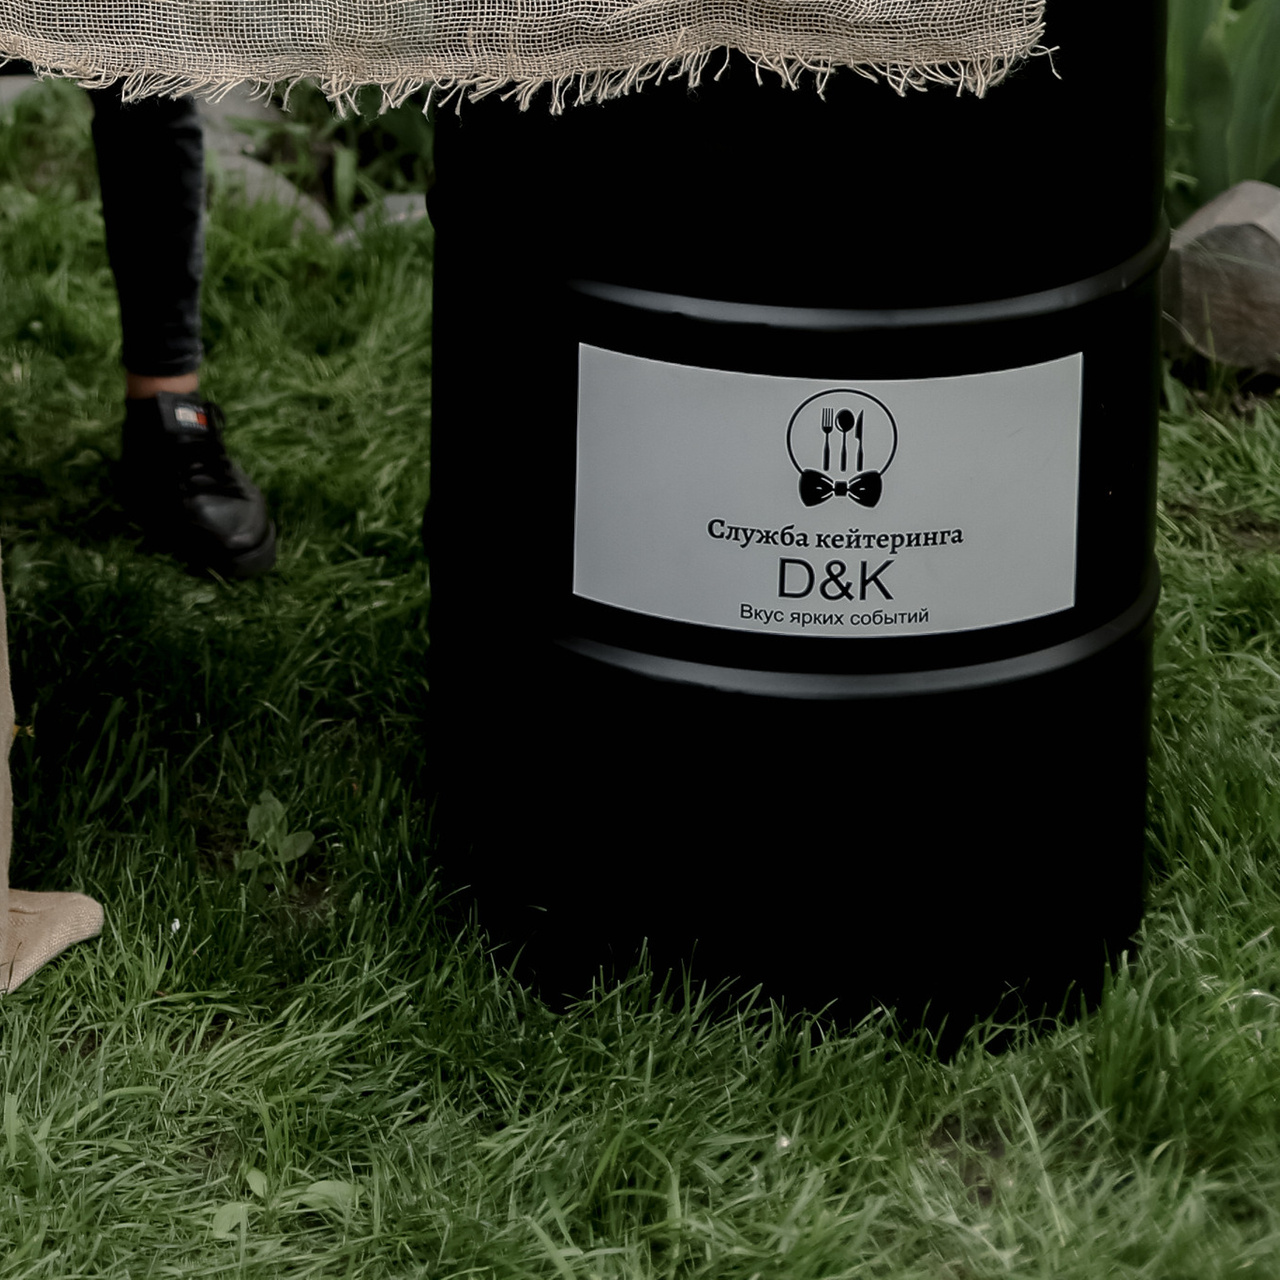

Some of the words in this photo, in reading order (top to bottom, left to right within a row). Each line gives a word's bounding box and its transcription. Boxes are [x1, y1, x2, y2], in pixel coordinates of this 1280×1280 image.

[707, 518, 810, 549] Служба
[816, 527, 965, 554] кейтеринга
[778, 557, 895, 602] D&K
[740, 603, 784, 624] Вкус
[789, 610, 844, 628] ярких
[850, 607, 930, 626] событий
